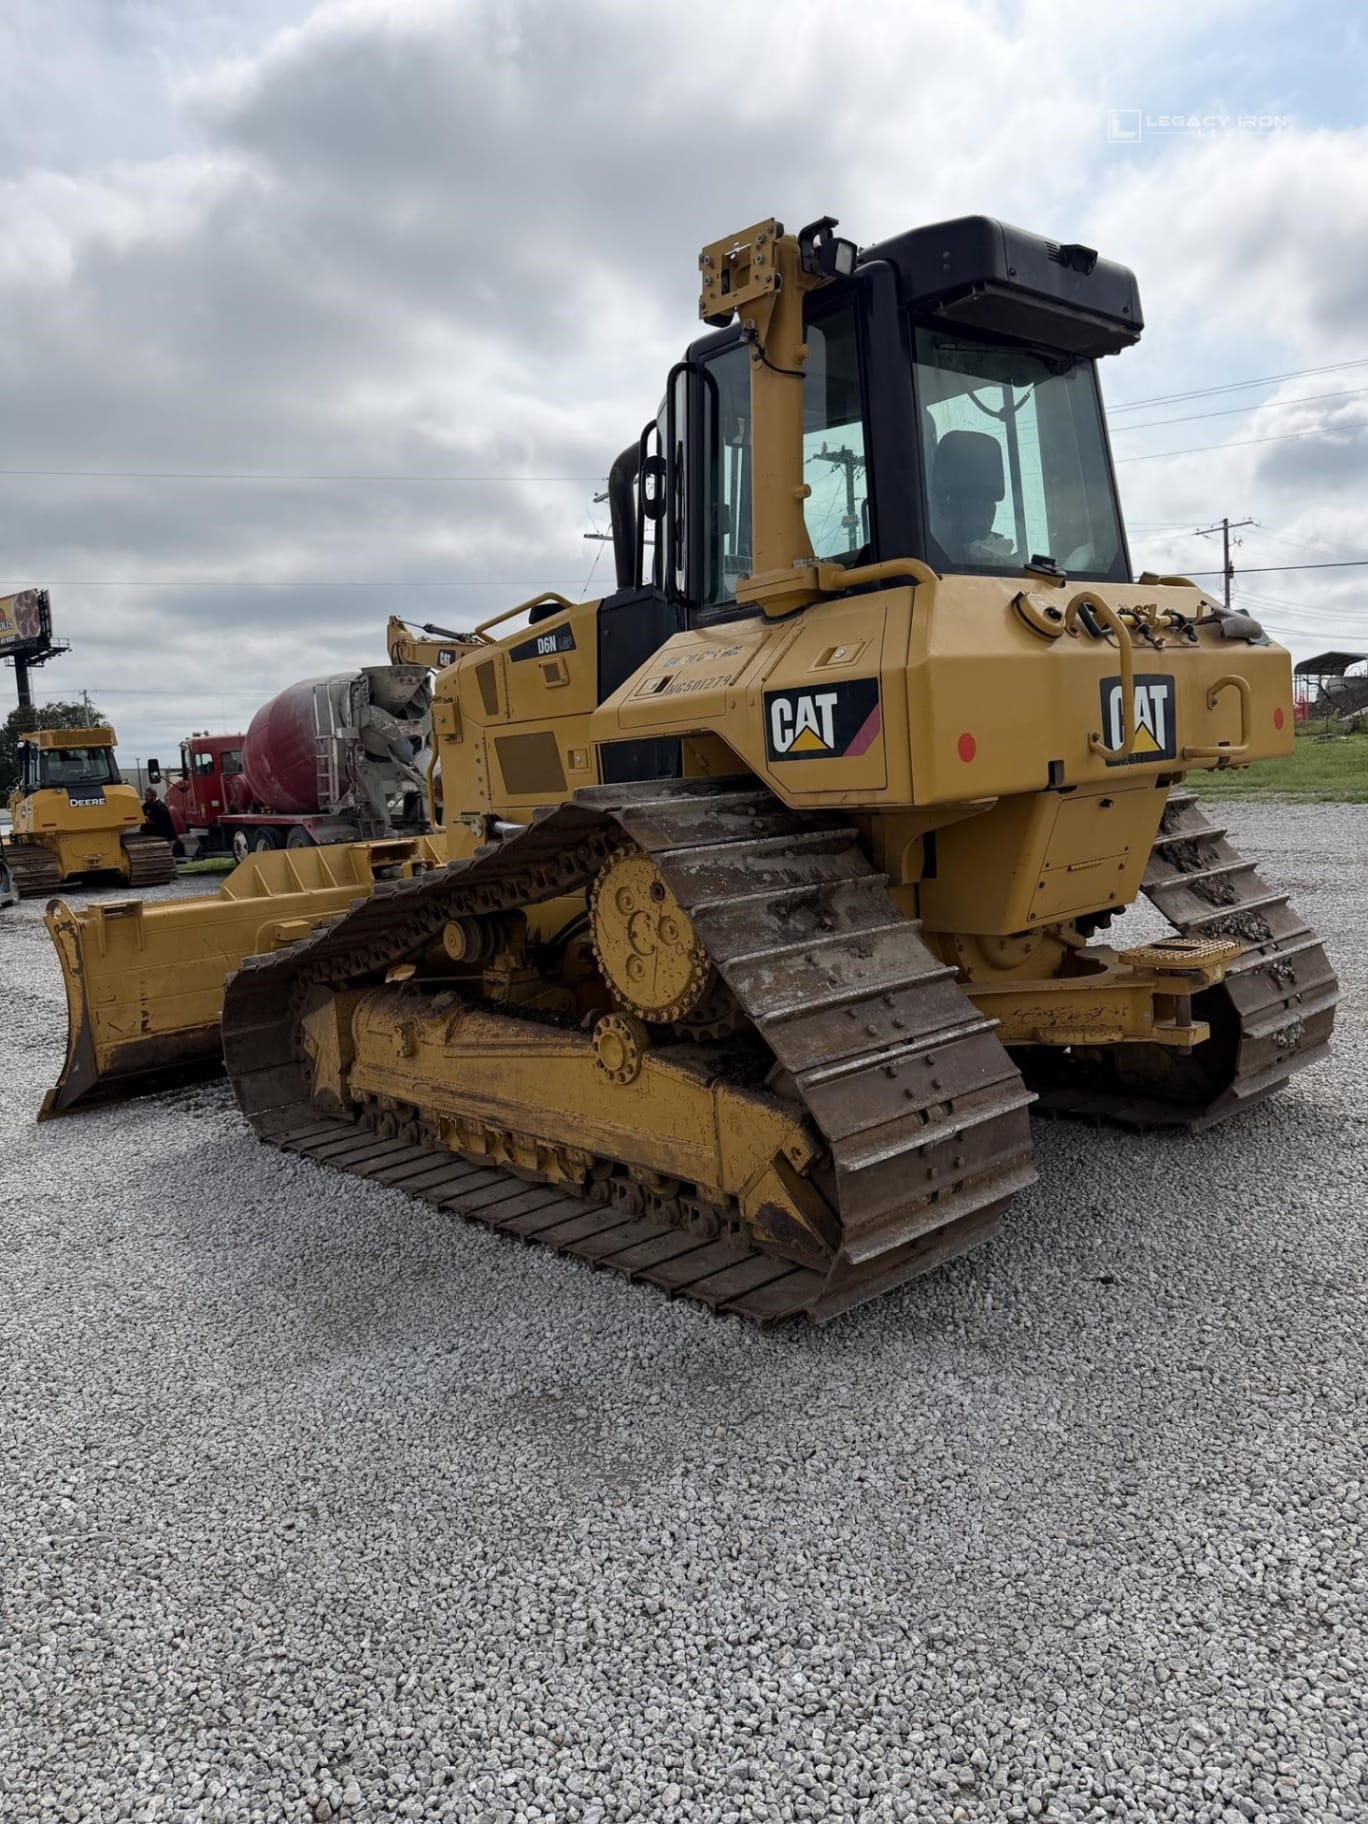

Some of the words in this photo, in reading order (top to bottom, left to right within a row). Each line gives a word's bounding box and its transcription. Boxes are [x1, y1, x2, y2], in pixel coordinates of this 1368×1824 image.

[537, 634, 557, 655] D6N
[439, 650, 452, 666] CAT
[771, 692, 838, 753] CAT
[69, 797, 106, 808] DEERE
